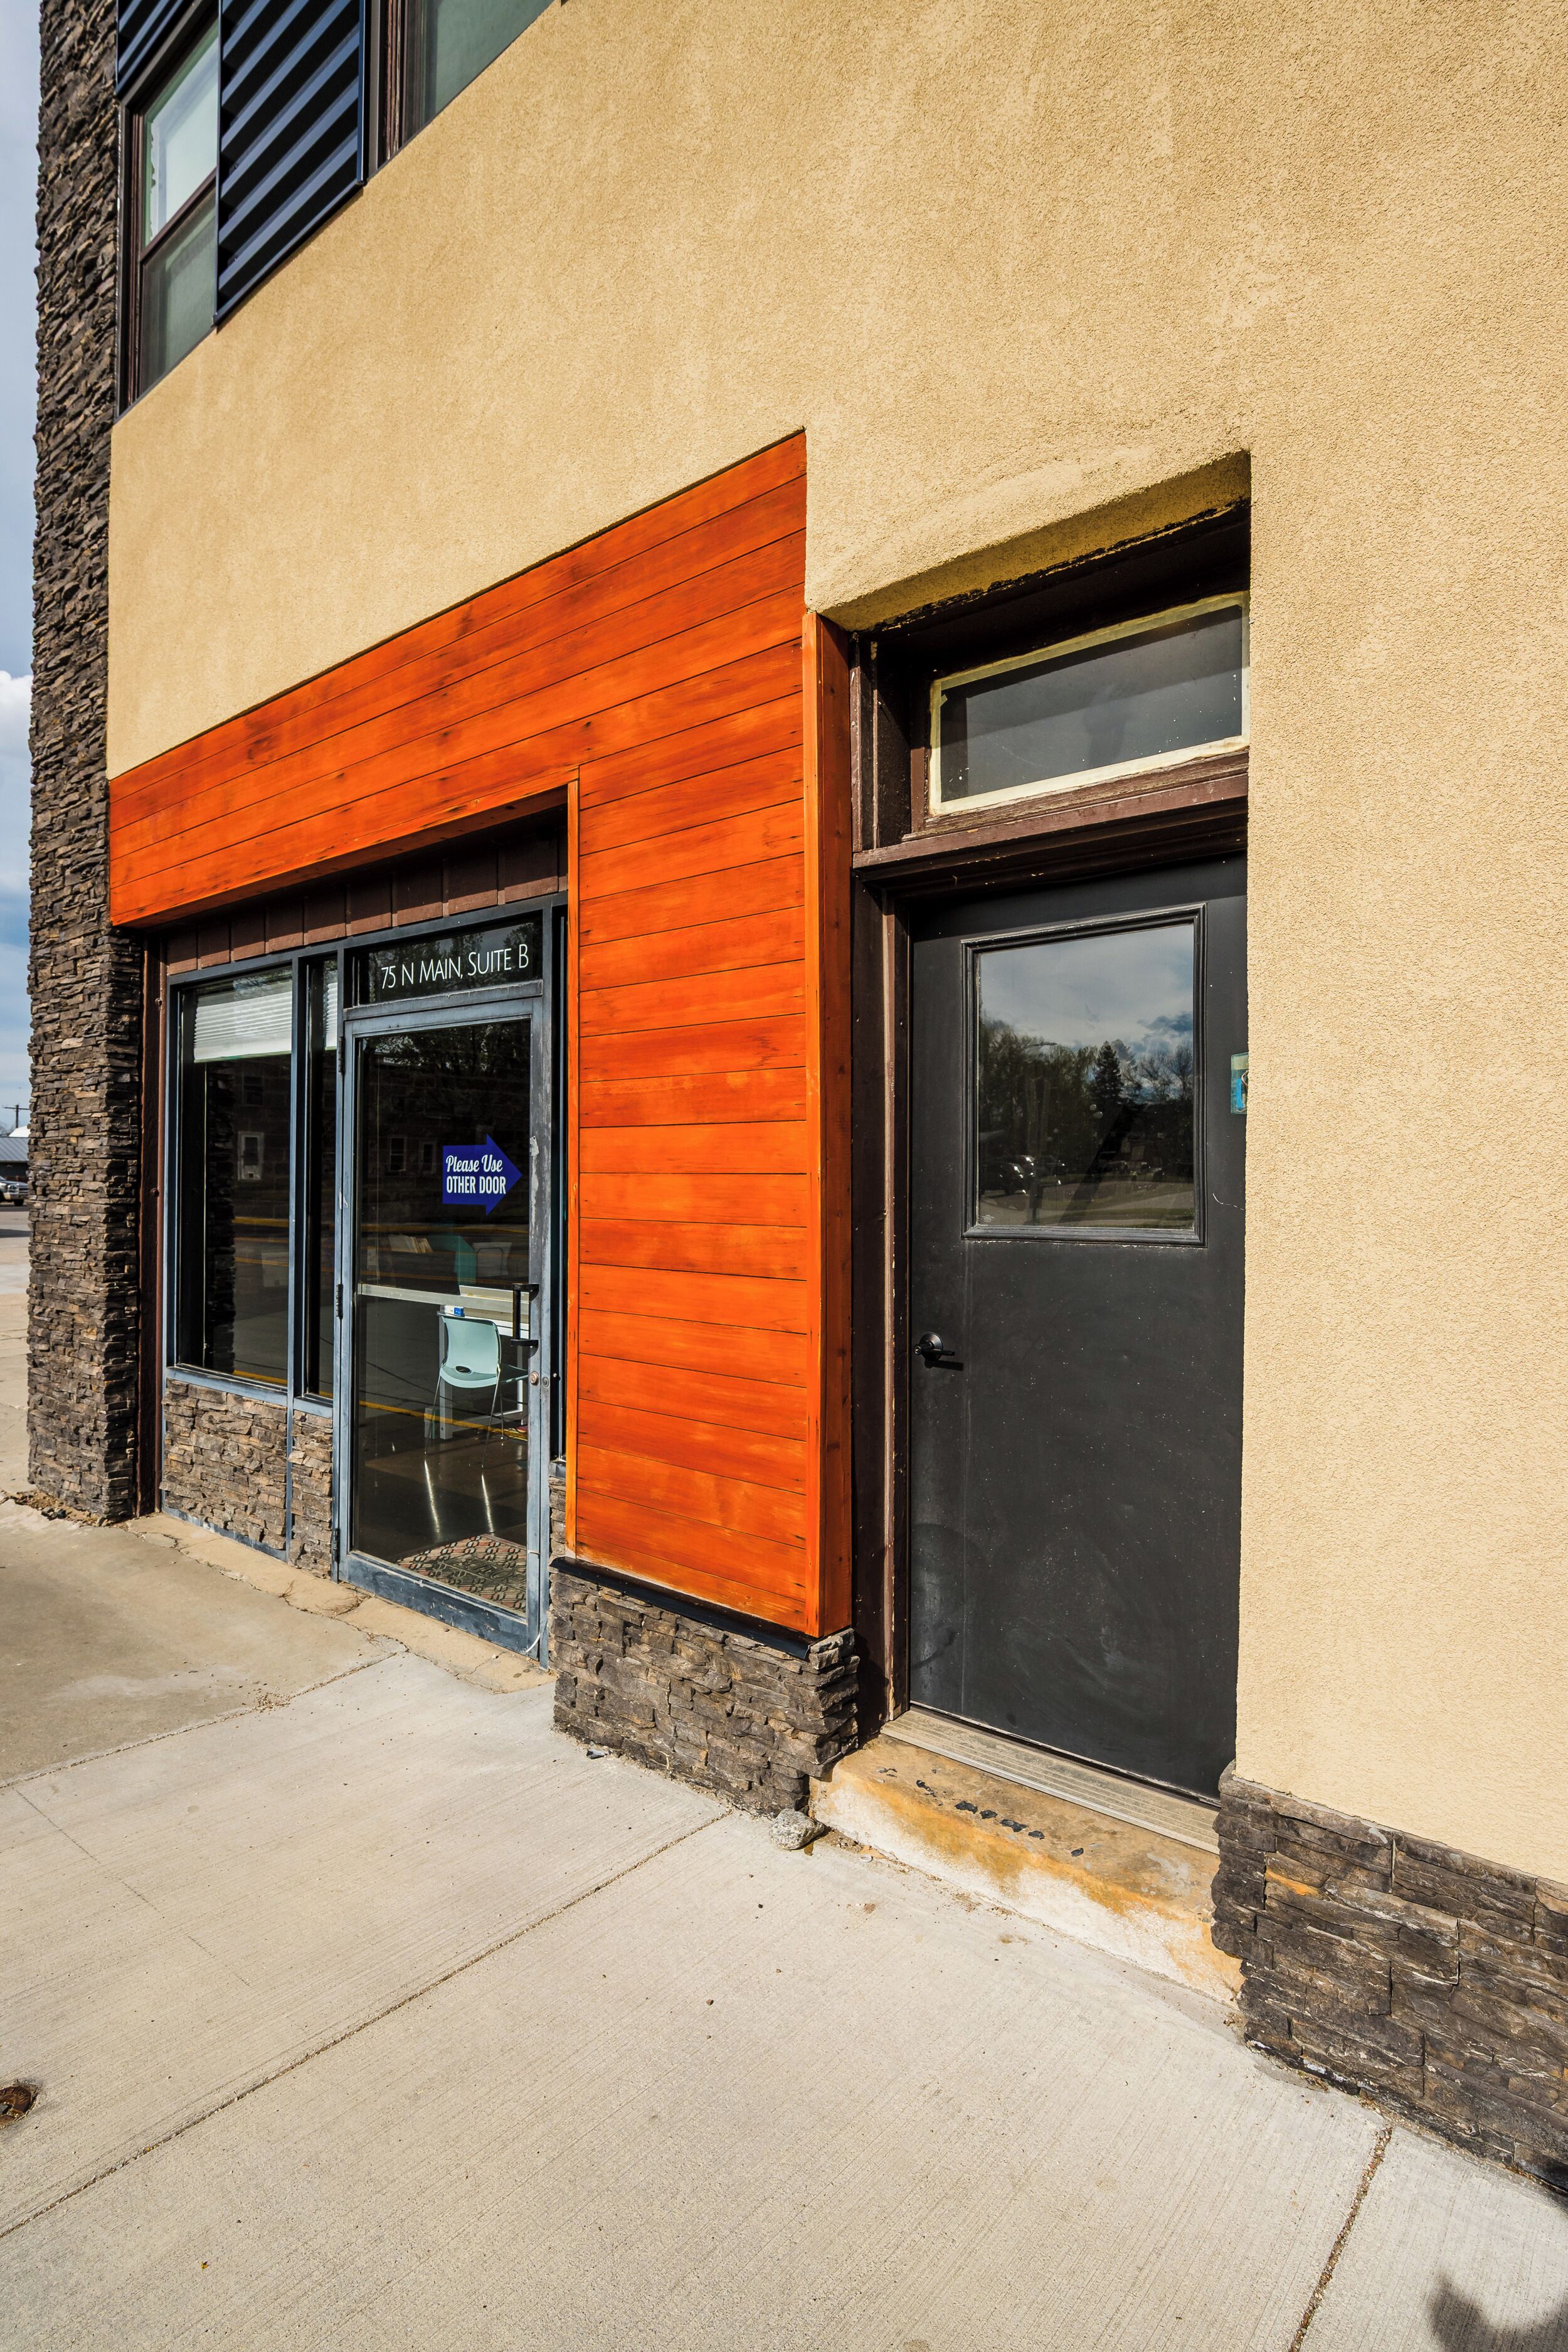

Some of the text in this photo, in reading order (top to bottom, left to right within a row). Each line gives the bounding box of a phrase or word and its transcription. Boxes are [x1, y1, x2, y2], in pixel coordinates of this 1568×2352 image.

[381, 944, 529, 989] 75 N MAIN, SUITE B
[446, 1155, 503, 1172] Please Use
[447, 1176, 506, 1194] OTHER DOOR
